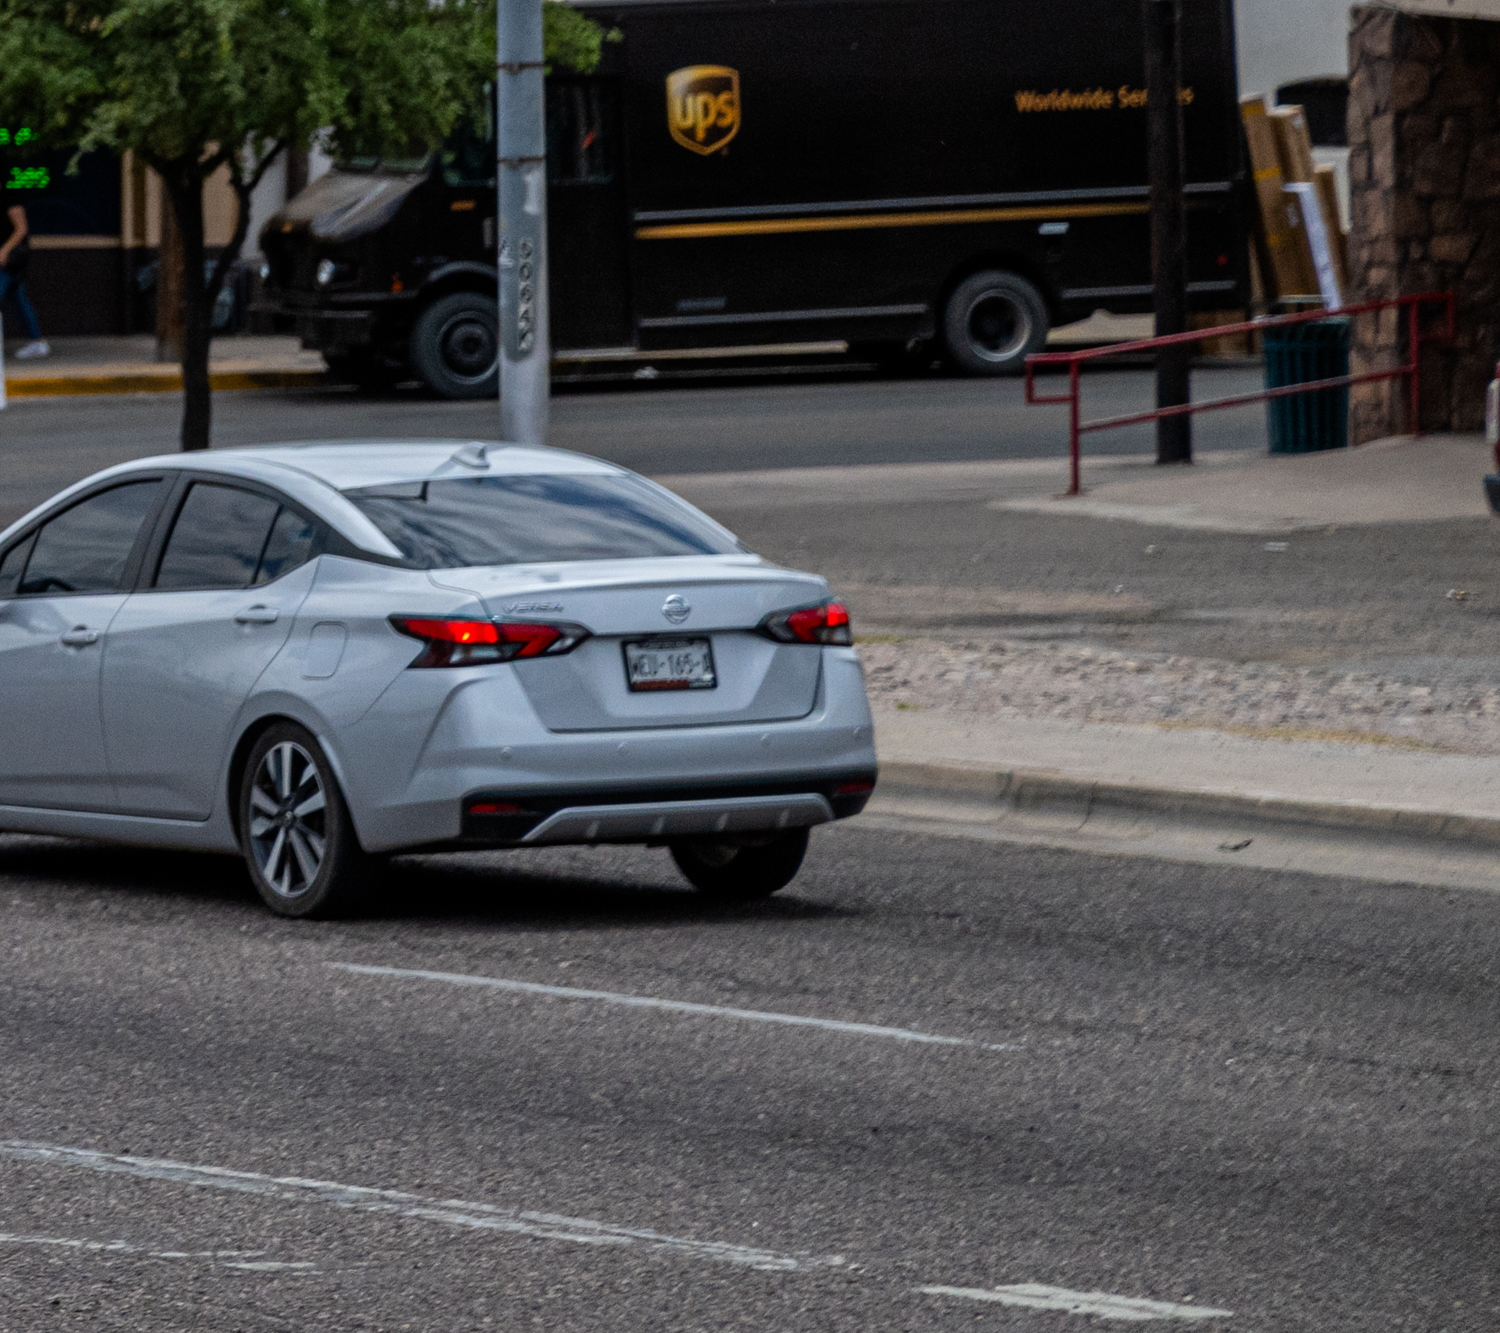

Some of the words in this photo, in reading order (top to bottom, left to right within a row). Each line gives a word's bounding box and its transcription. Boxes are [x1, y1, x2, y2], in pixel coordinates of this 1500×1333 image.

[675, 90, 735, 142] ups
[1014, 87, 1114, 113] Worldwide
[1118, 84, 1195, 109] Seres
